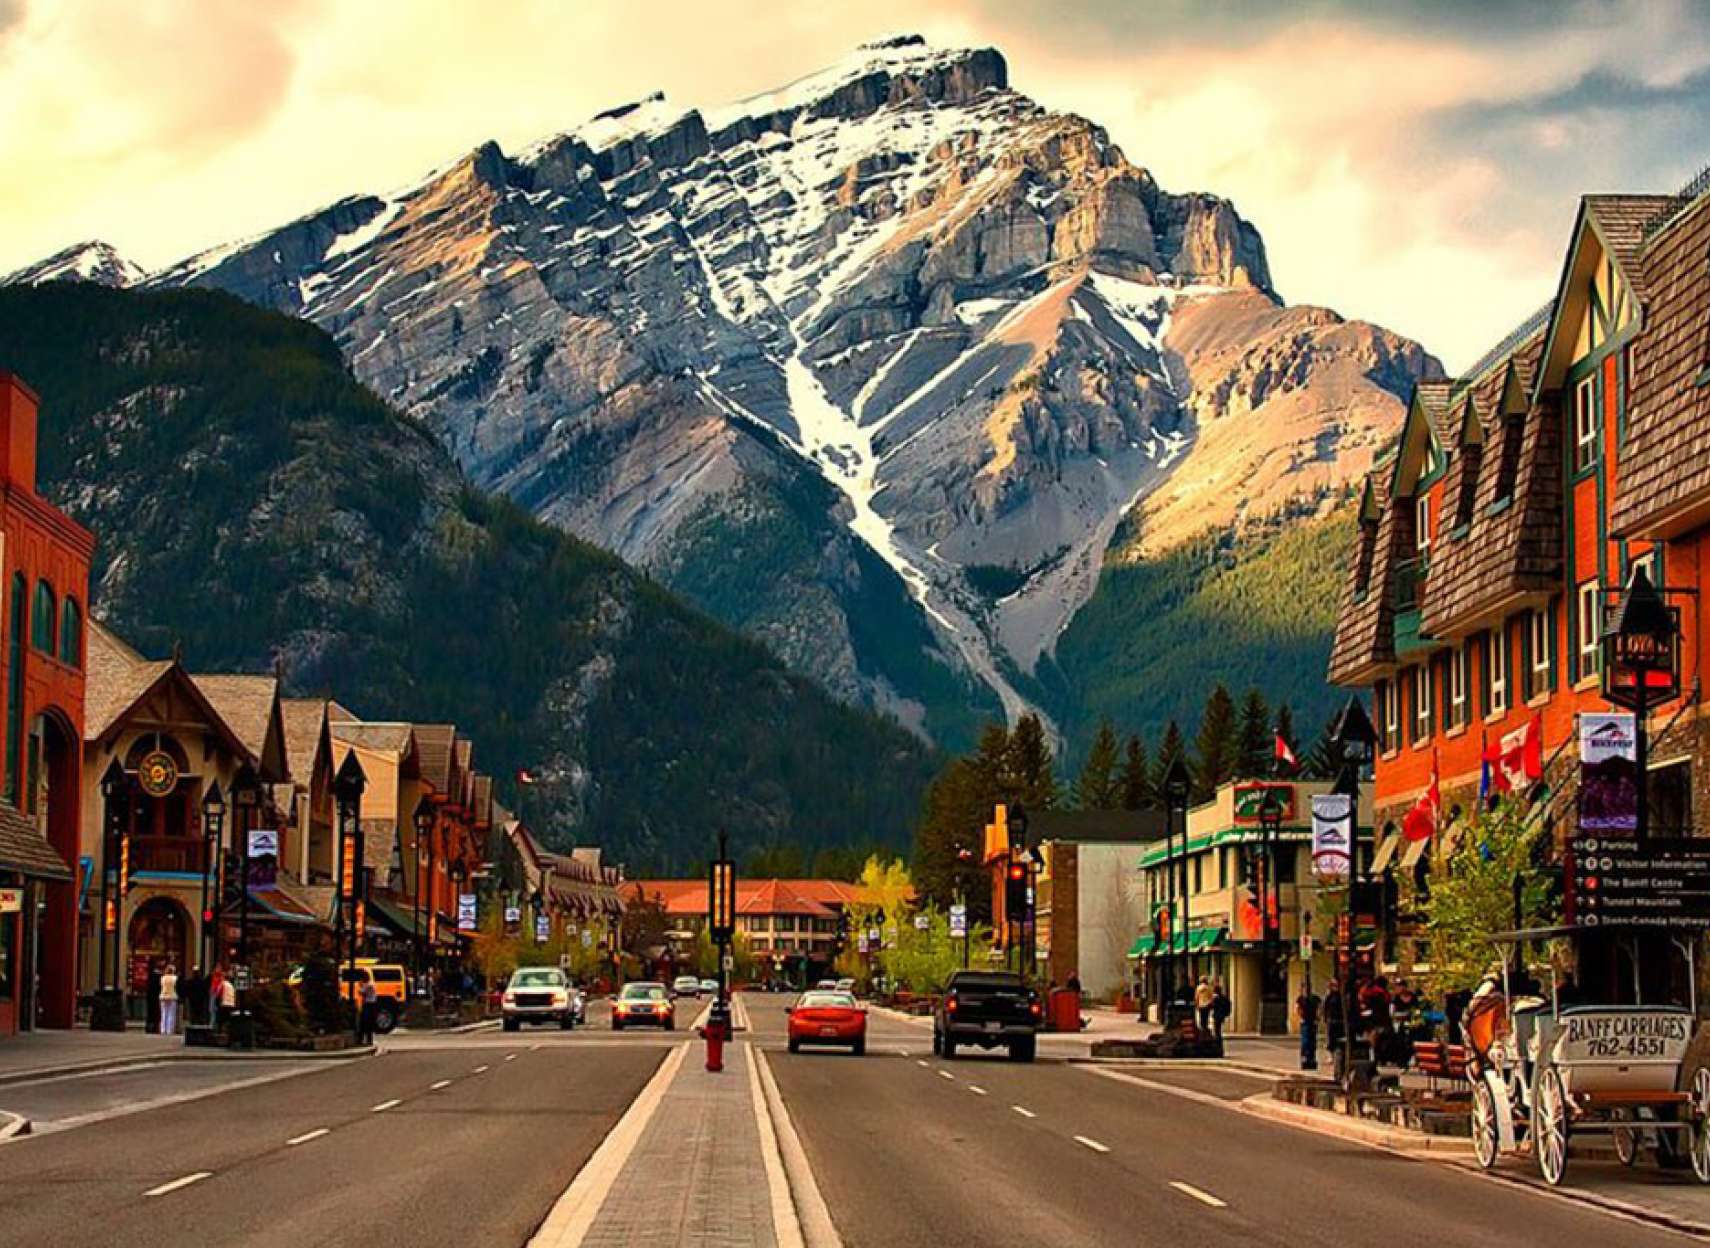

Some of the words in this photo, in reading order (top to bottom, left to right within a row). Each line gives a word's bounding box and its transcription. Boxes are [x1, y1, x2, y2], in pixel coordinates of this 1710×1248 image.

[1601, 840, 1638, 852] Parking
[1651, 859, 1707, 869] Information
[1602, 878, 1619, 888] The
[1623, 878, 1648, 888] Banff
[1637, 897, 1681, 907] Mountain
[1670, 916, 1709, 927] Highway
[1569, 1018, 1612, 1041] BANFF
[1613, 1016, 1686, 1040] CARRIAGES
[1588, 1037, 1665, 1056] 762-4551
